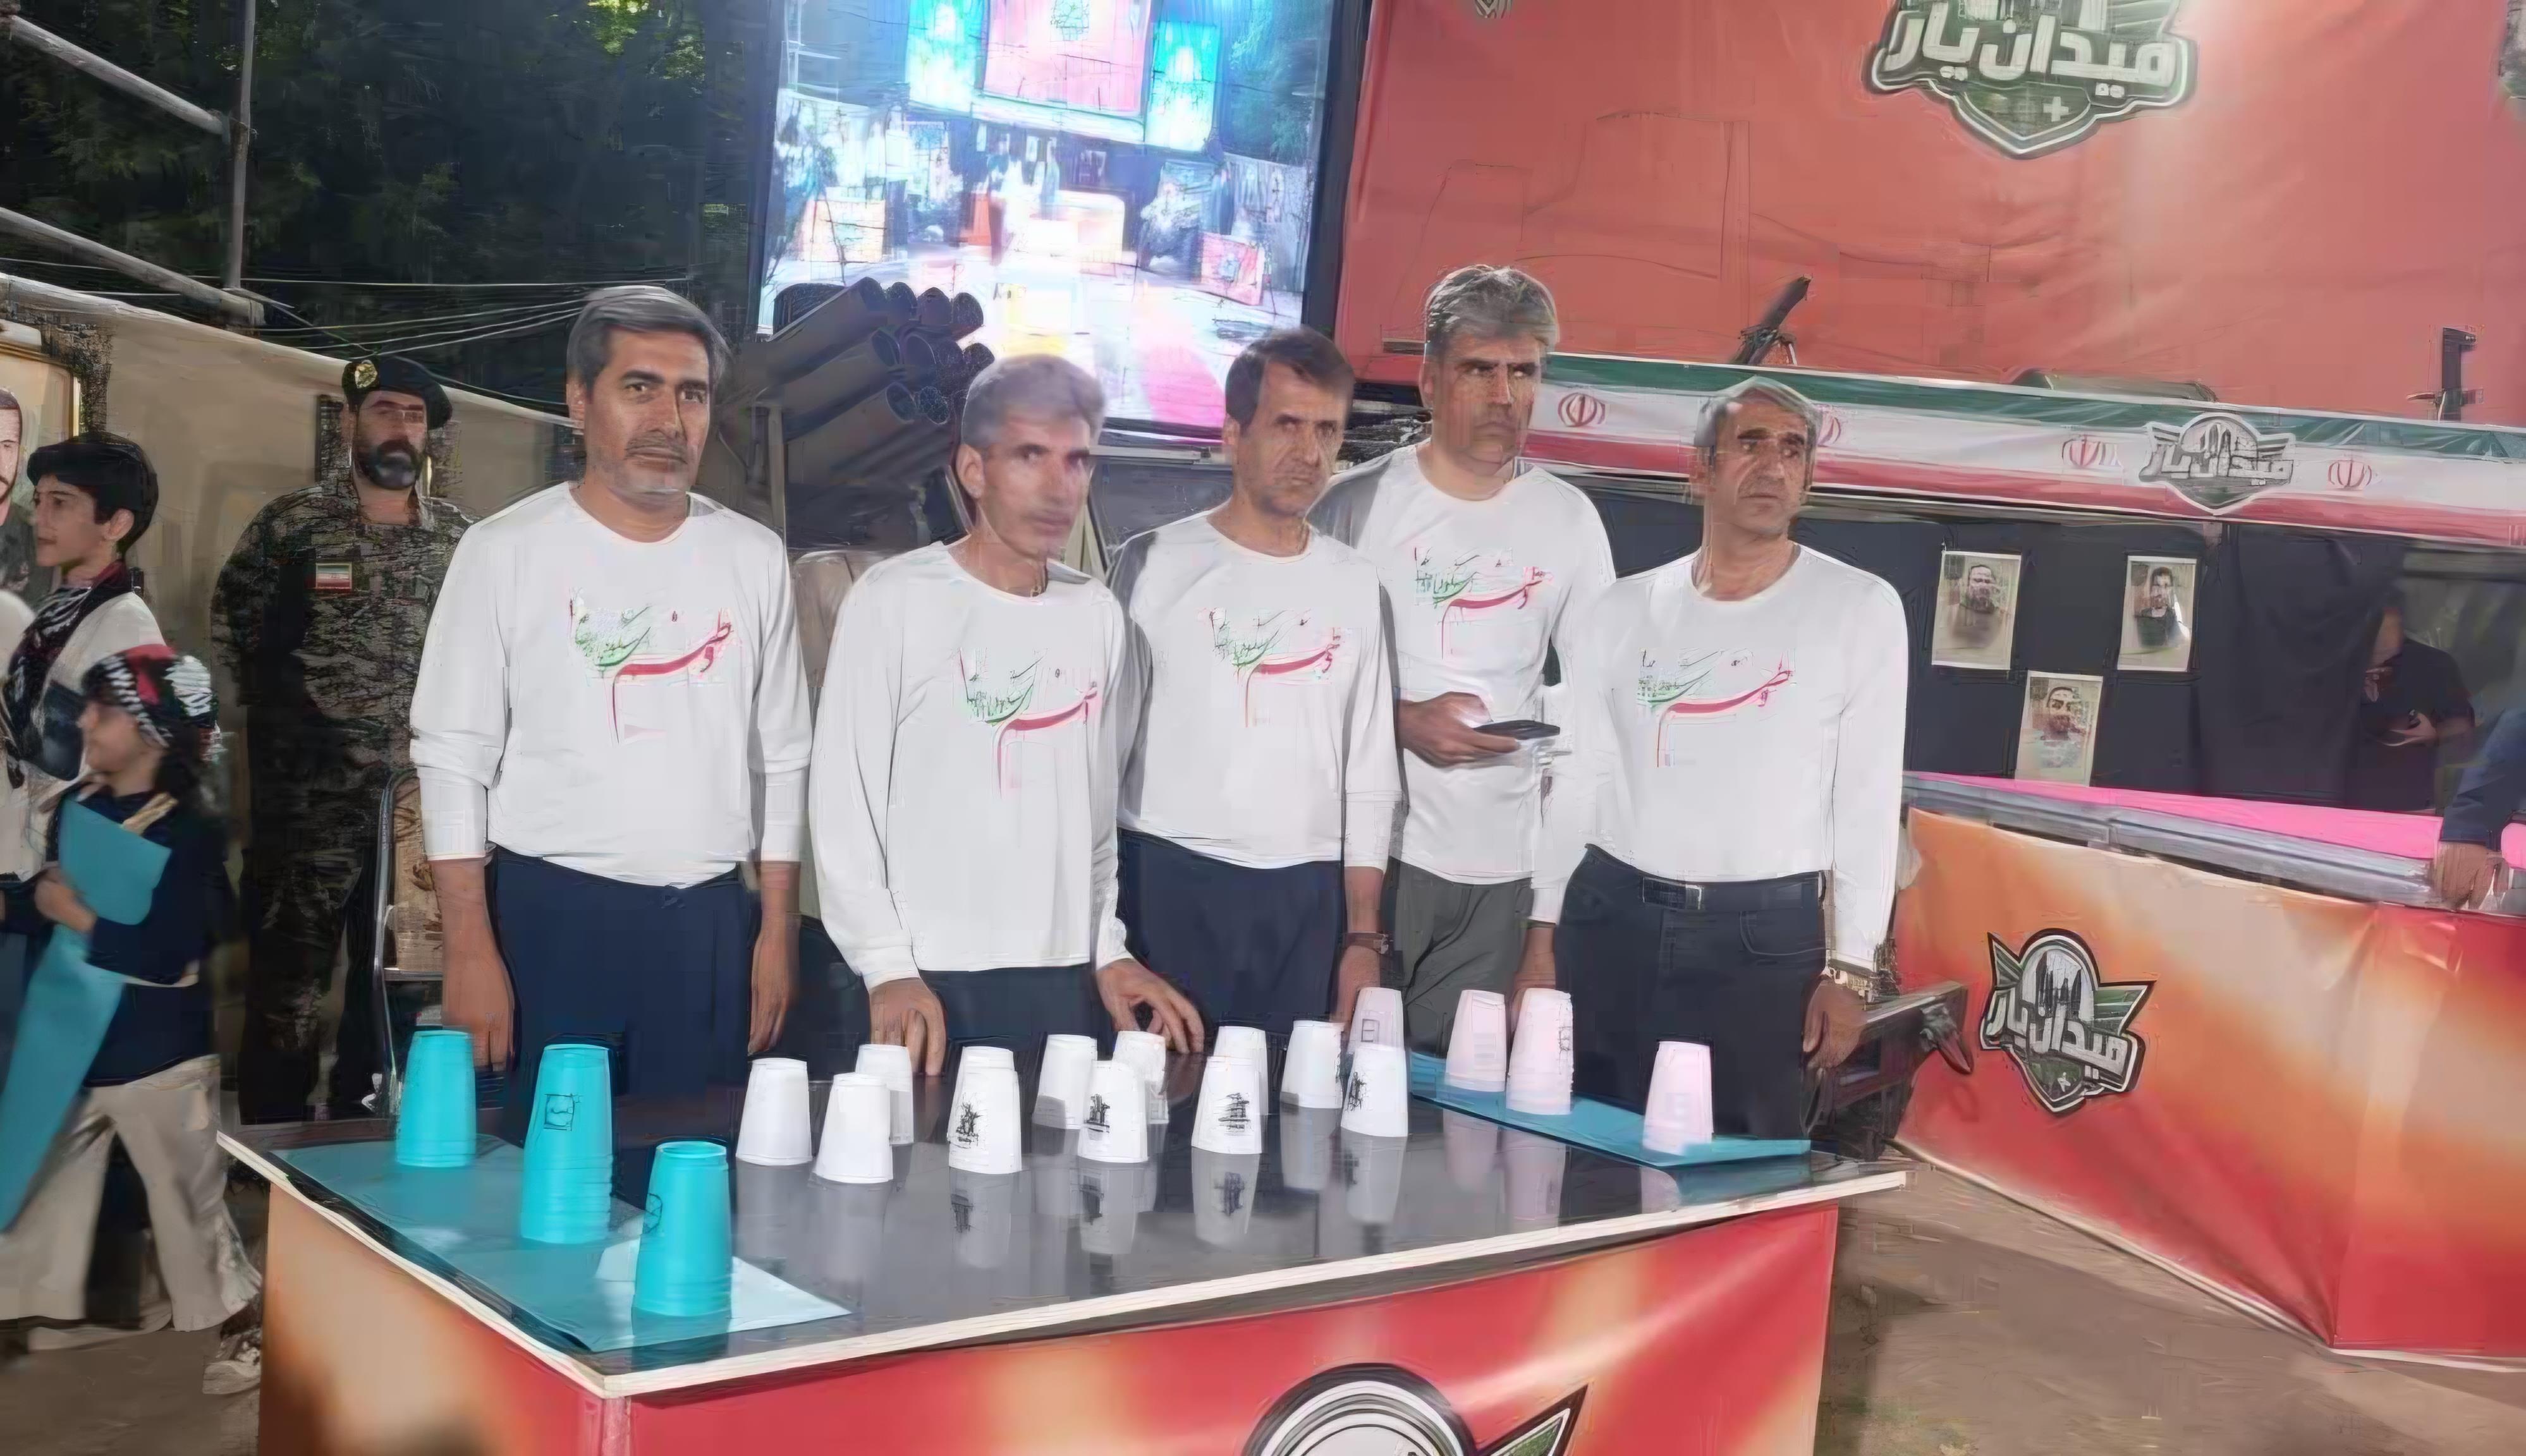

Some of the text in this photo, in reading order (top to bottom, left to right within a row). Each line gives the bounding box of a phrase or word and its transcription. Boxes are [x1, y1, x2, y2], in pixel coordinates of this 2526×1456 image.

[1882, 1, 2176, 99] میدان یار
[2190, 451, 2293, 485] میدان
[1986, 987, 2128, 1080] میدان یار
